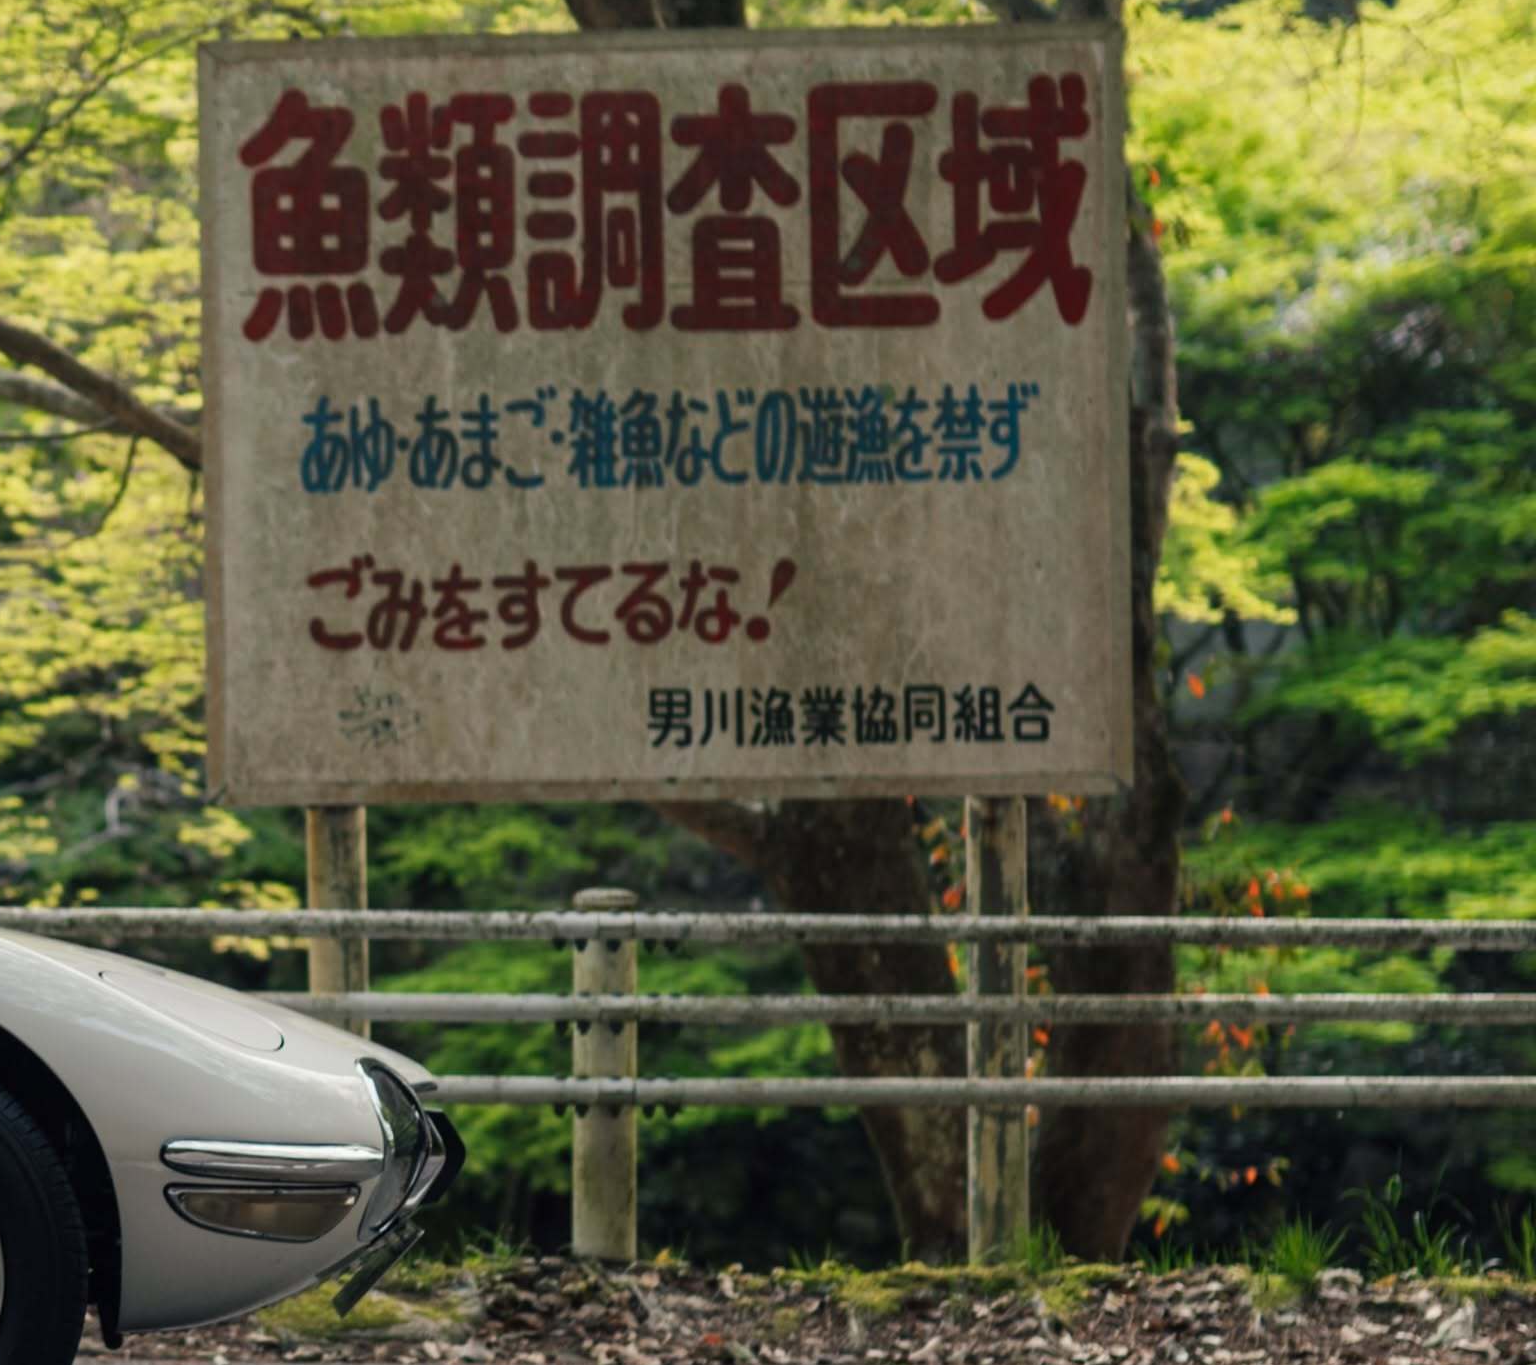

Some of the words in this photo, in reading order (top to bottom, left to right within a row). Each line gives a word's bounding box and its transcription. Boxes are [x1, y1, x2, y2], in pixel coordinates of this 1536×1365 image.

[239, 73, 1093, 342] 魚類調査区域
[647, 681, 1056, 749] 男川漁業協同組合
